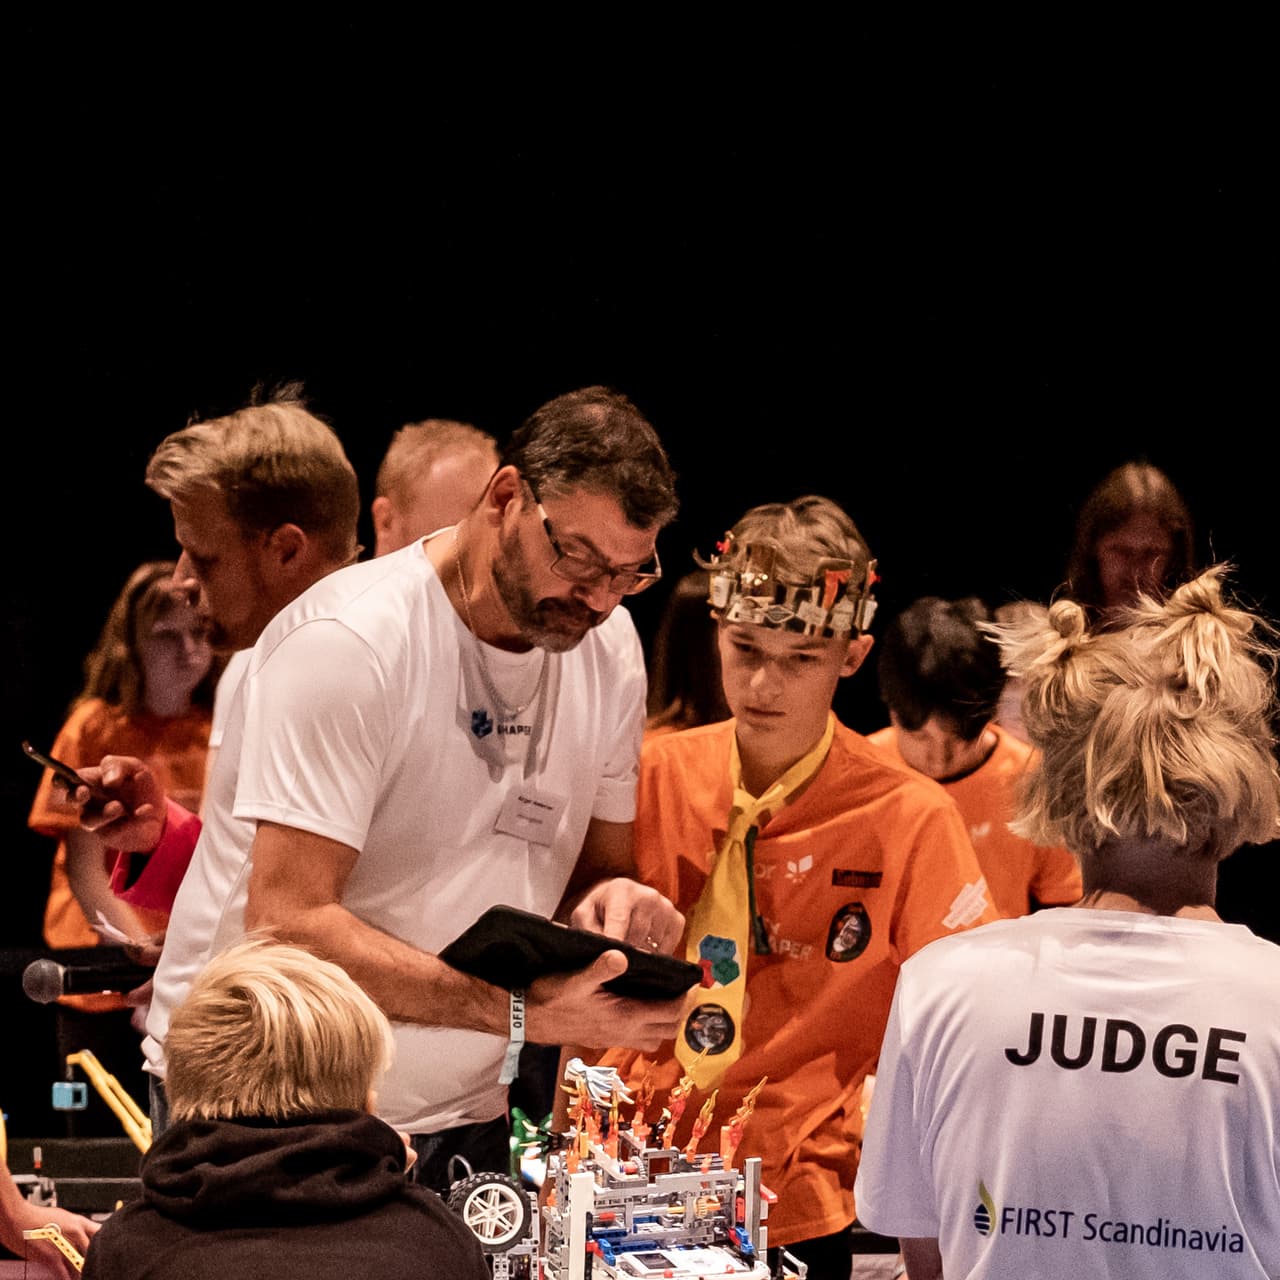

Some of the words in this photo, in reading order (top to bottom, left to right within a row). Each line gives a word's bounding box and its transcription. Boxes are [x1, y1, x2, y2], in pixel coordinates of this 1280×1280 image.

[1004, 1012, 1247, 1085] JUDGE
[1001, 1207, 1074, 1239] FIRST
[1083, 1213, 1244, 1253] Scandinavia
